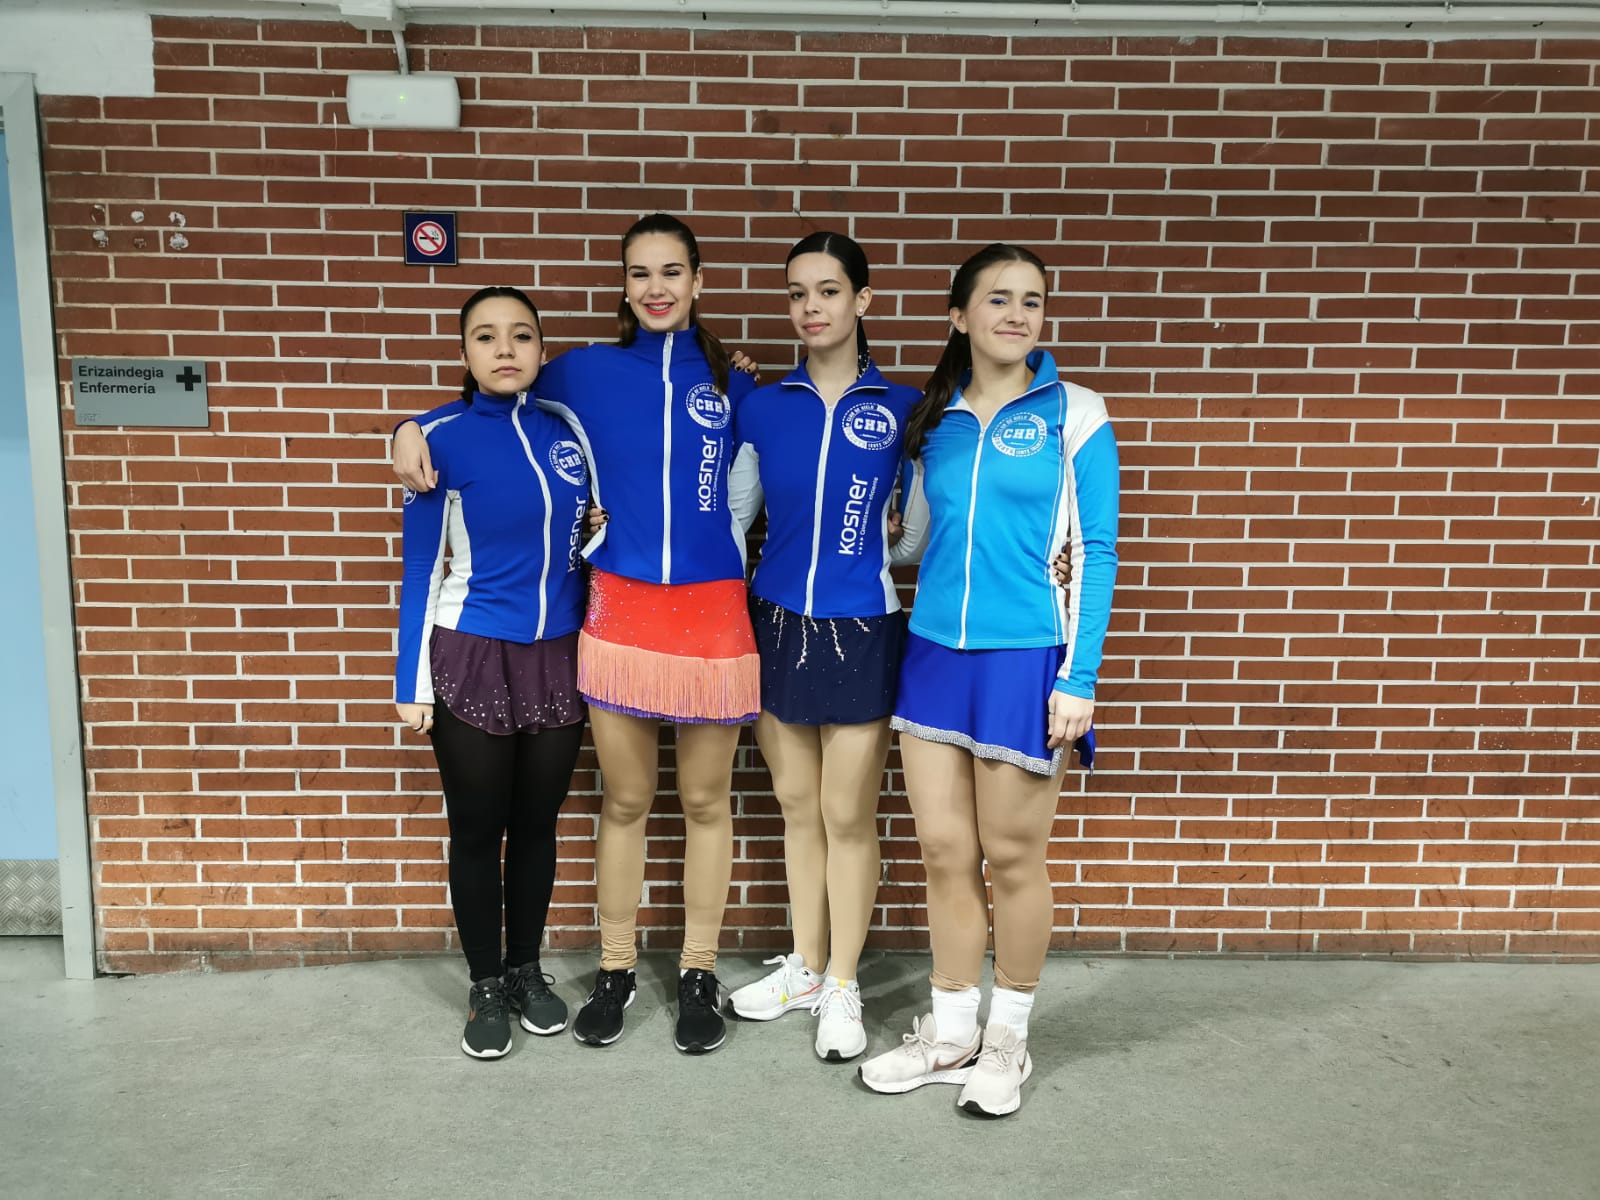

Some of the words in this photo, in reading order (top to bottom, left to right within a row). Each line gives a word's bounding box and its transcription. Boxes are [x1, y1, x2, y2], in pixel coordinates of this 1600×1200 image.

[78, 365, 164, 380] Erizaindegia
[695, 398, 724, 415] CHH
[853, 417, 888, 434] CHH
[1003, 428, 1036, 440] CHH
[559, 453, 582, 469] CHH
